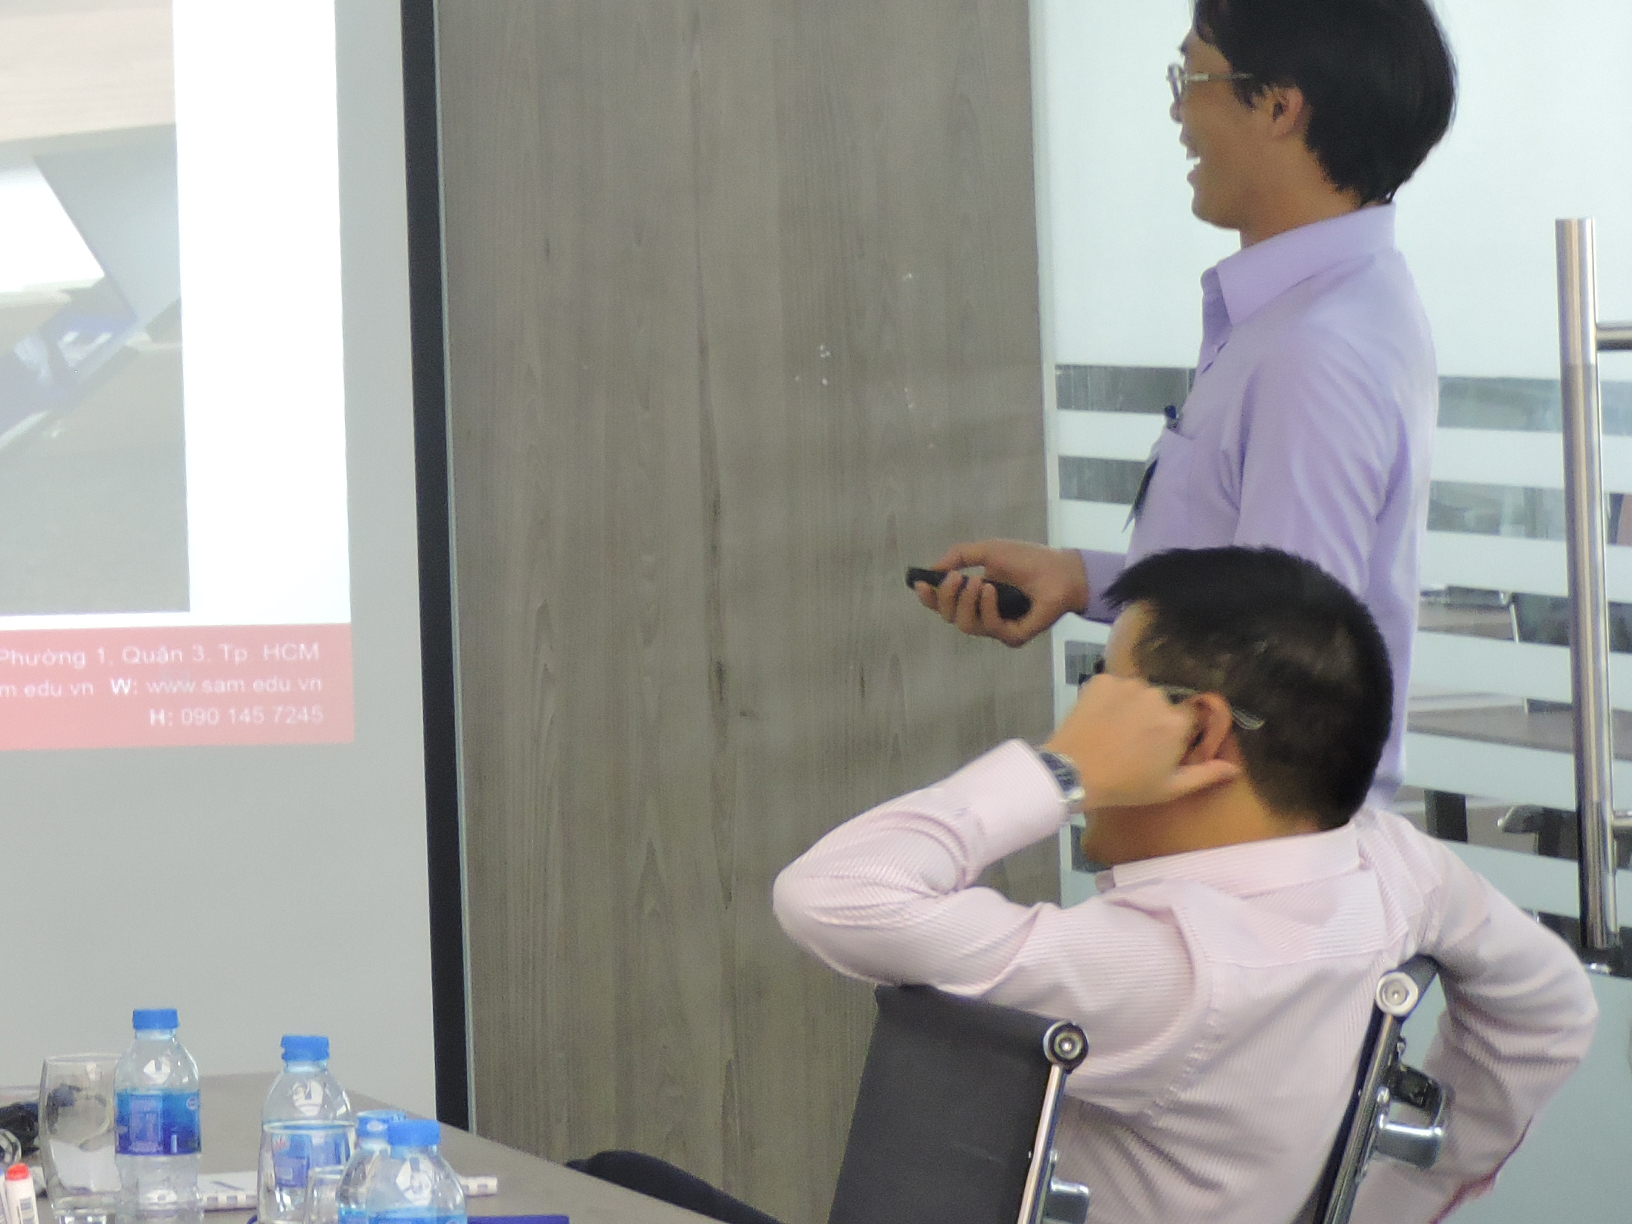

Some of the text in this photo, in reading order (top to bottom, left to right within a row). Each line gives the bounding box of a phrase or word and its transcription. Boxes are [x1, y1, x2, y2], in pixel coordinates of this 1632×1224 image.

[262, 640, 321, 663] HCM
[109, 676, 138, 696] W:
[149, 704, 325, 728] H: 090 145 7245
